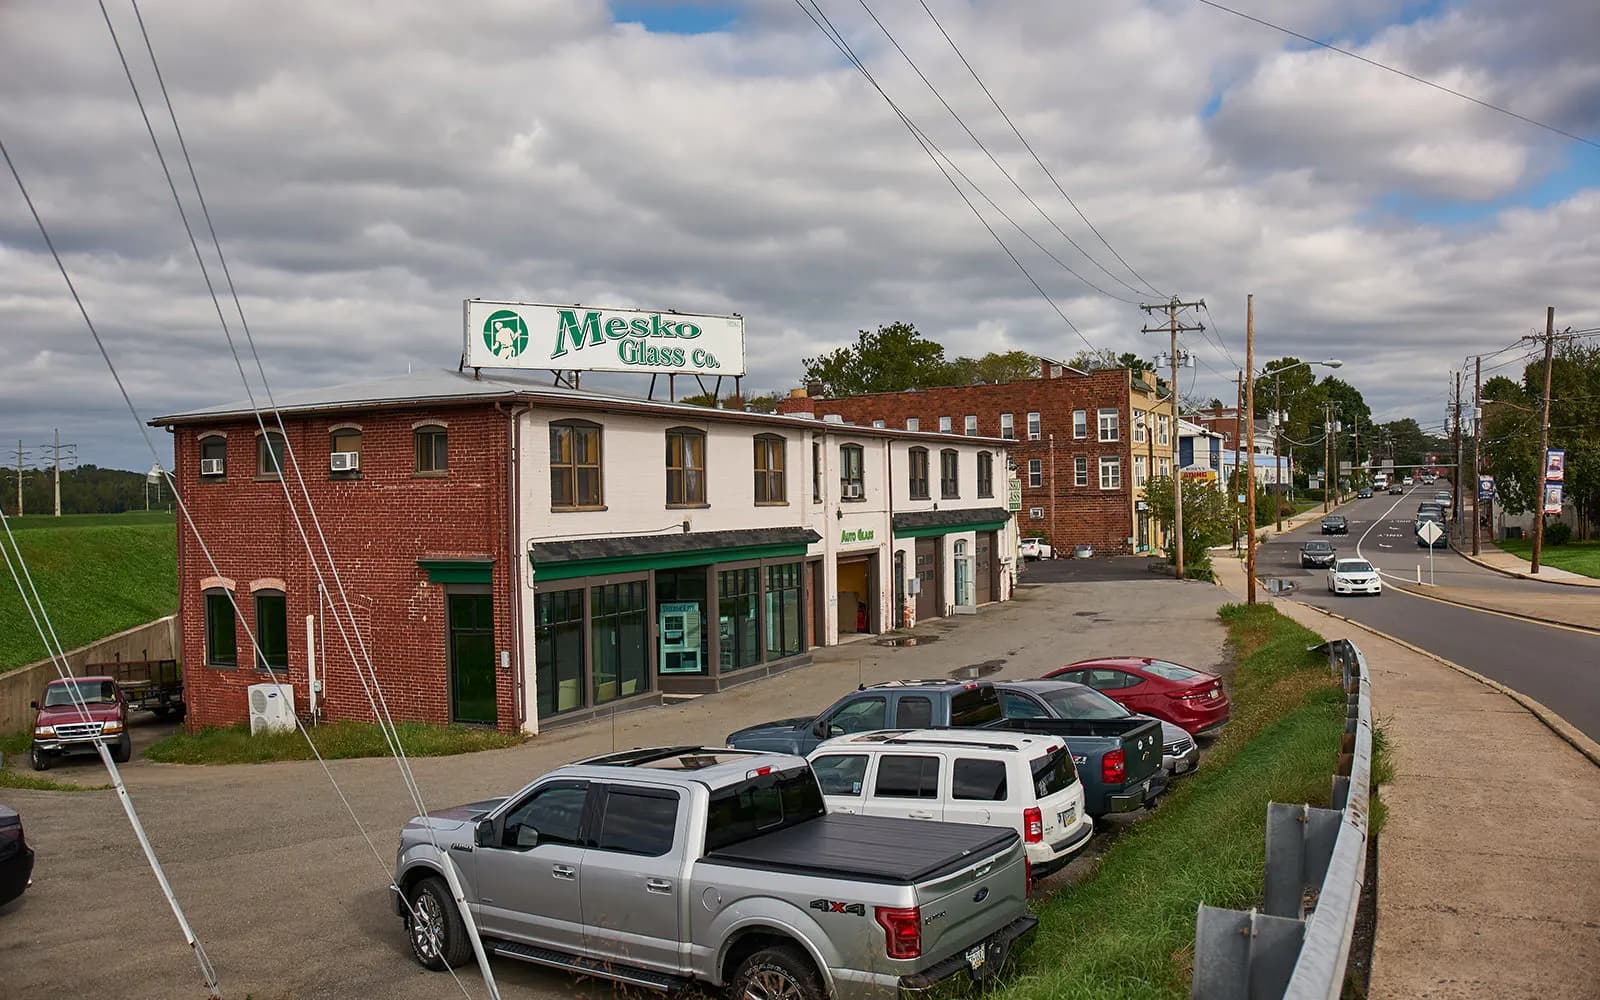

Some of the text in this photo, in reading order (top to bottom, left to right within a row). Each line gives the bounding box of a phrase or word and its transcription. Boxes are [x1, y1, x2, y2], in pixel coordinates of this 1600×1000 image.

[551, 310, 702, 359] Mesko
[619, 339, 720, 368] Glass Co.
